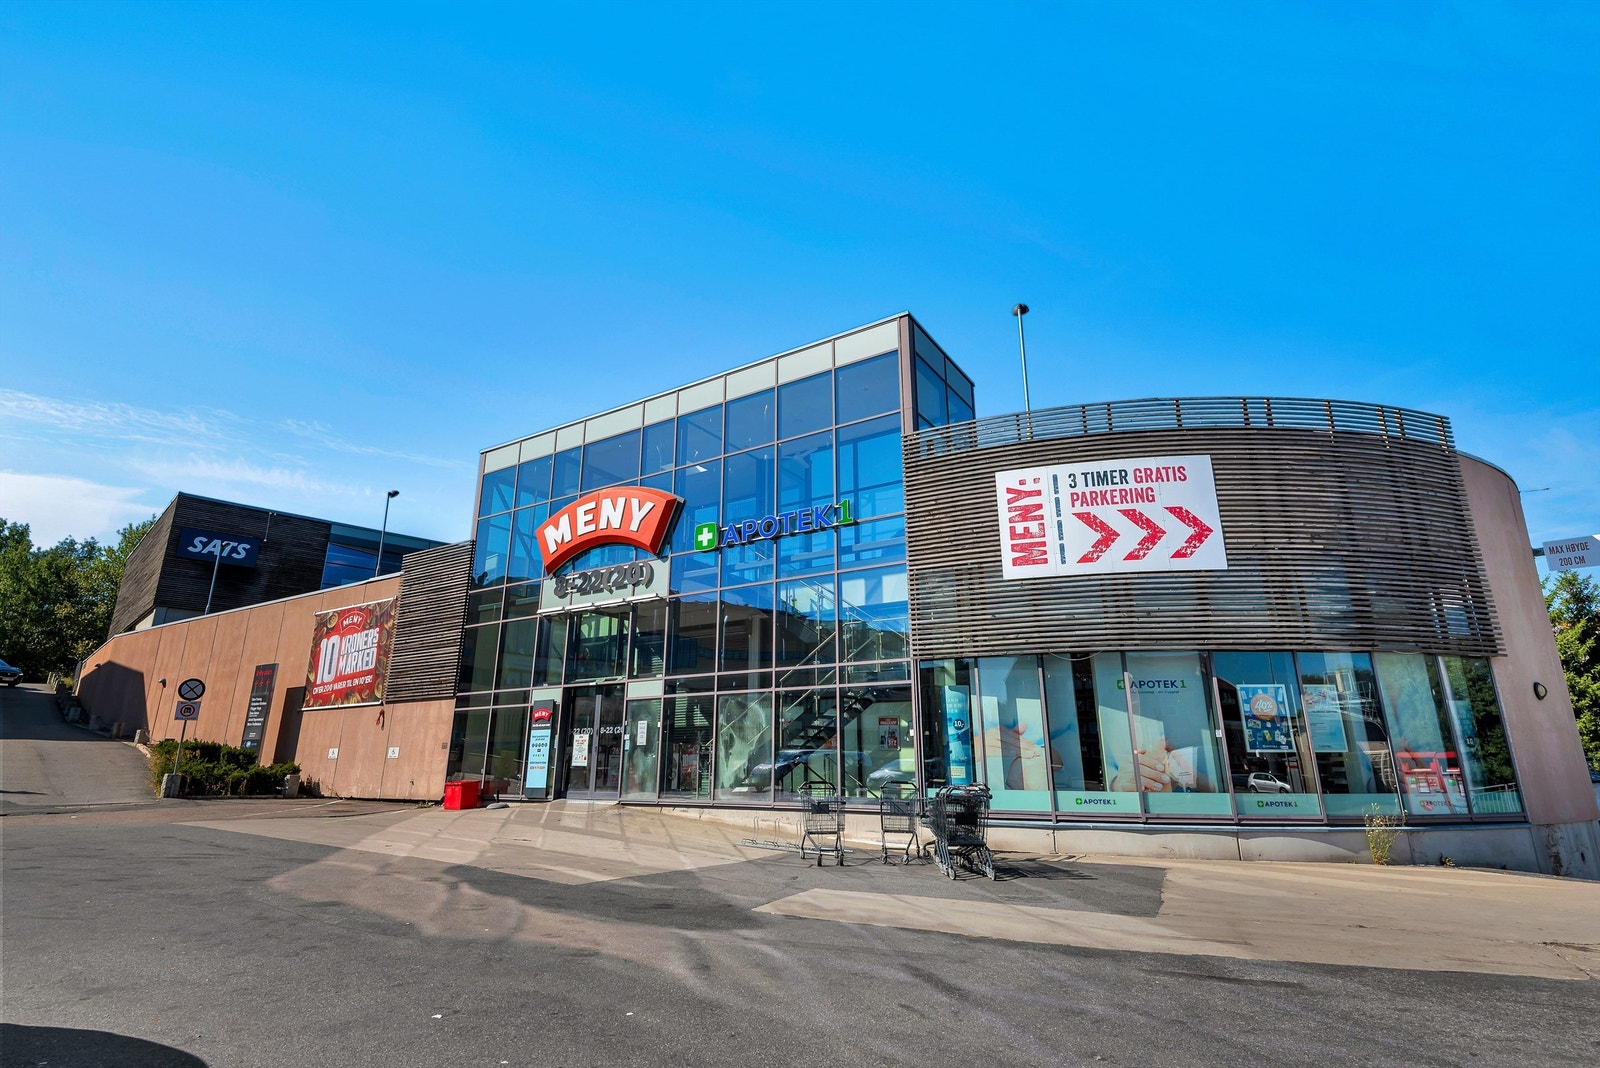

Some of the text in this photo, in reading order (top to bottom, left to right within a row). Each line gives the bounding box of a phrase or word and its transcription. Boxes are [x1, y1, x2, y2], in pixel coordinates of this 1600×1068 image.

[1068, 465, 1188, 489] 3 TIMER GRATIS
[1070, 487, 1156, 508] PARKERING
[543, 497, 656, 555] MENY
[722, 499, 854, 546] APOTEK 1
[1006, 477, 1048, 567] MENY:
[187, 536, 252, 559] SATS
[1548, 541, 1590, 555] MAX HØYDE
[1558, 555, 1586, 567] 200 CM
[342, 615, 363, 627] MENY
[316, 627, 380, 685] 10 KRONERS
[337, 647, 377, 676] MARKED
[1130, 679, 1187, 689] APOTEK 1
[534, 710, 549, 719] MENY
